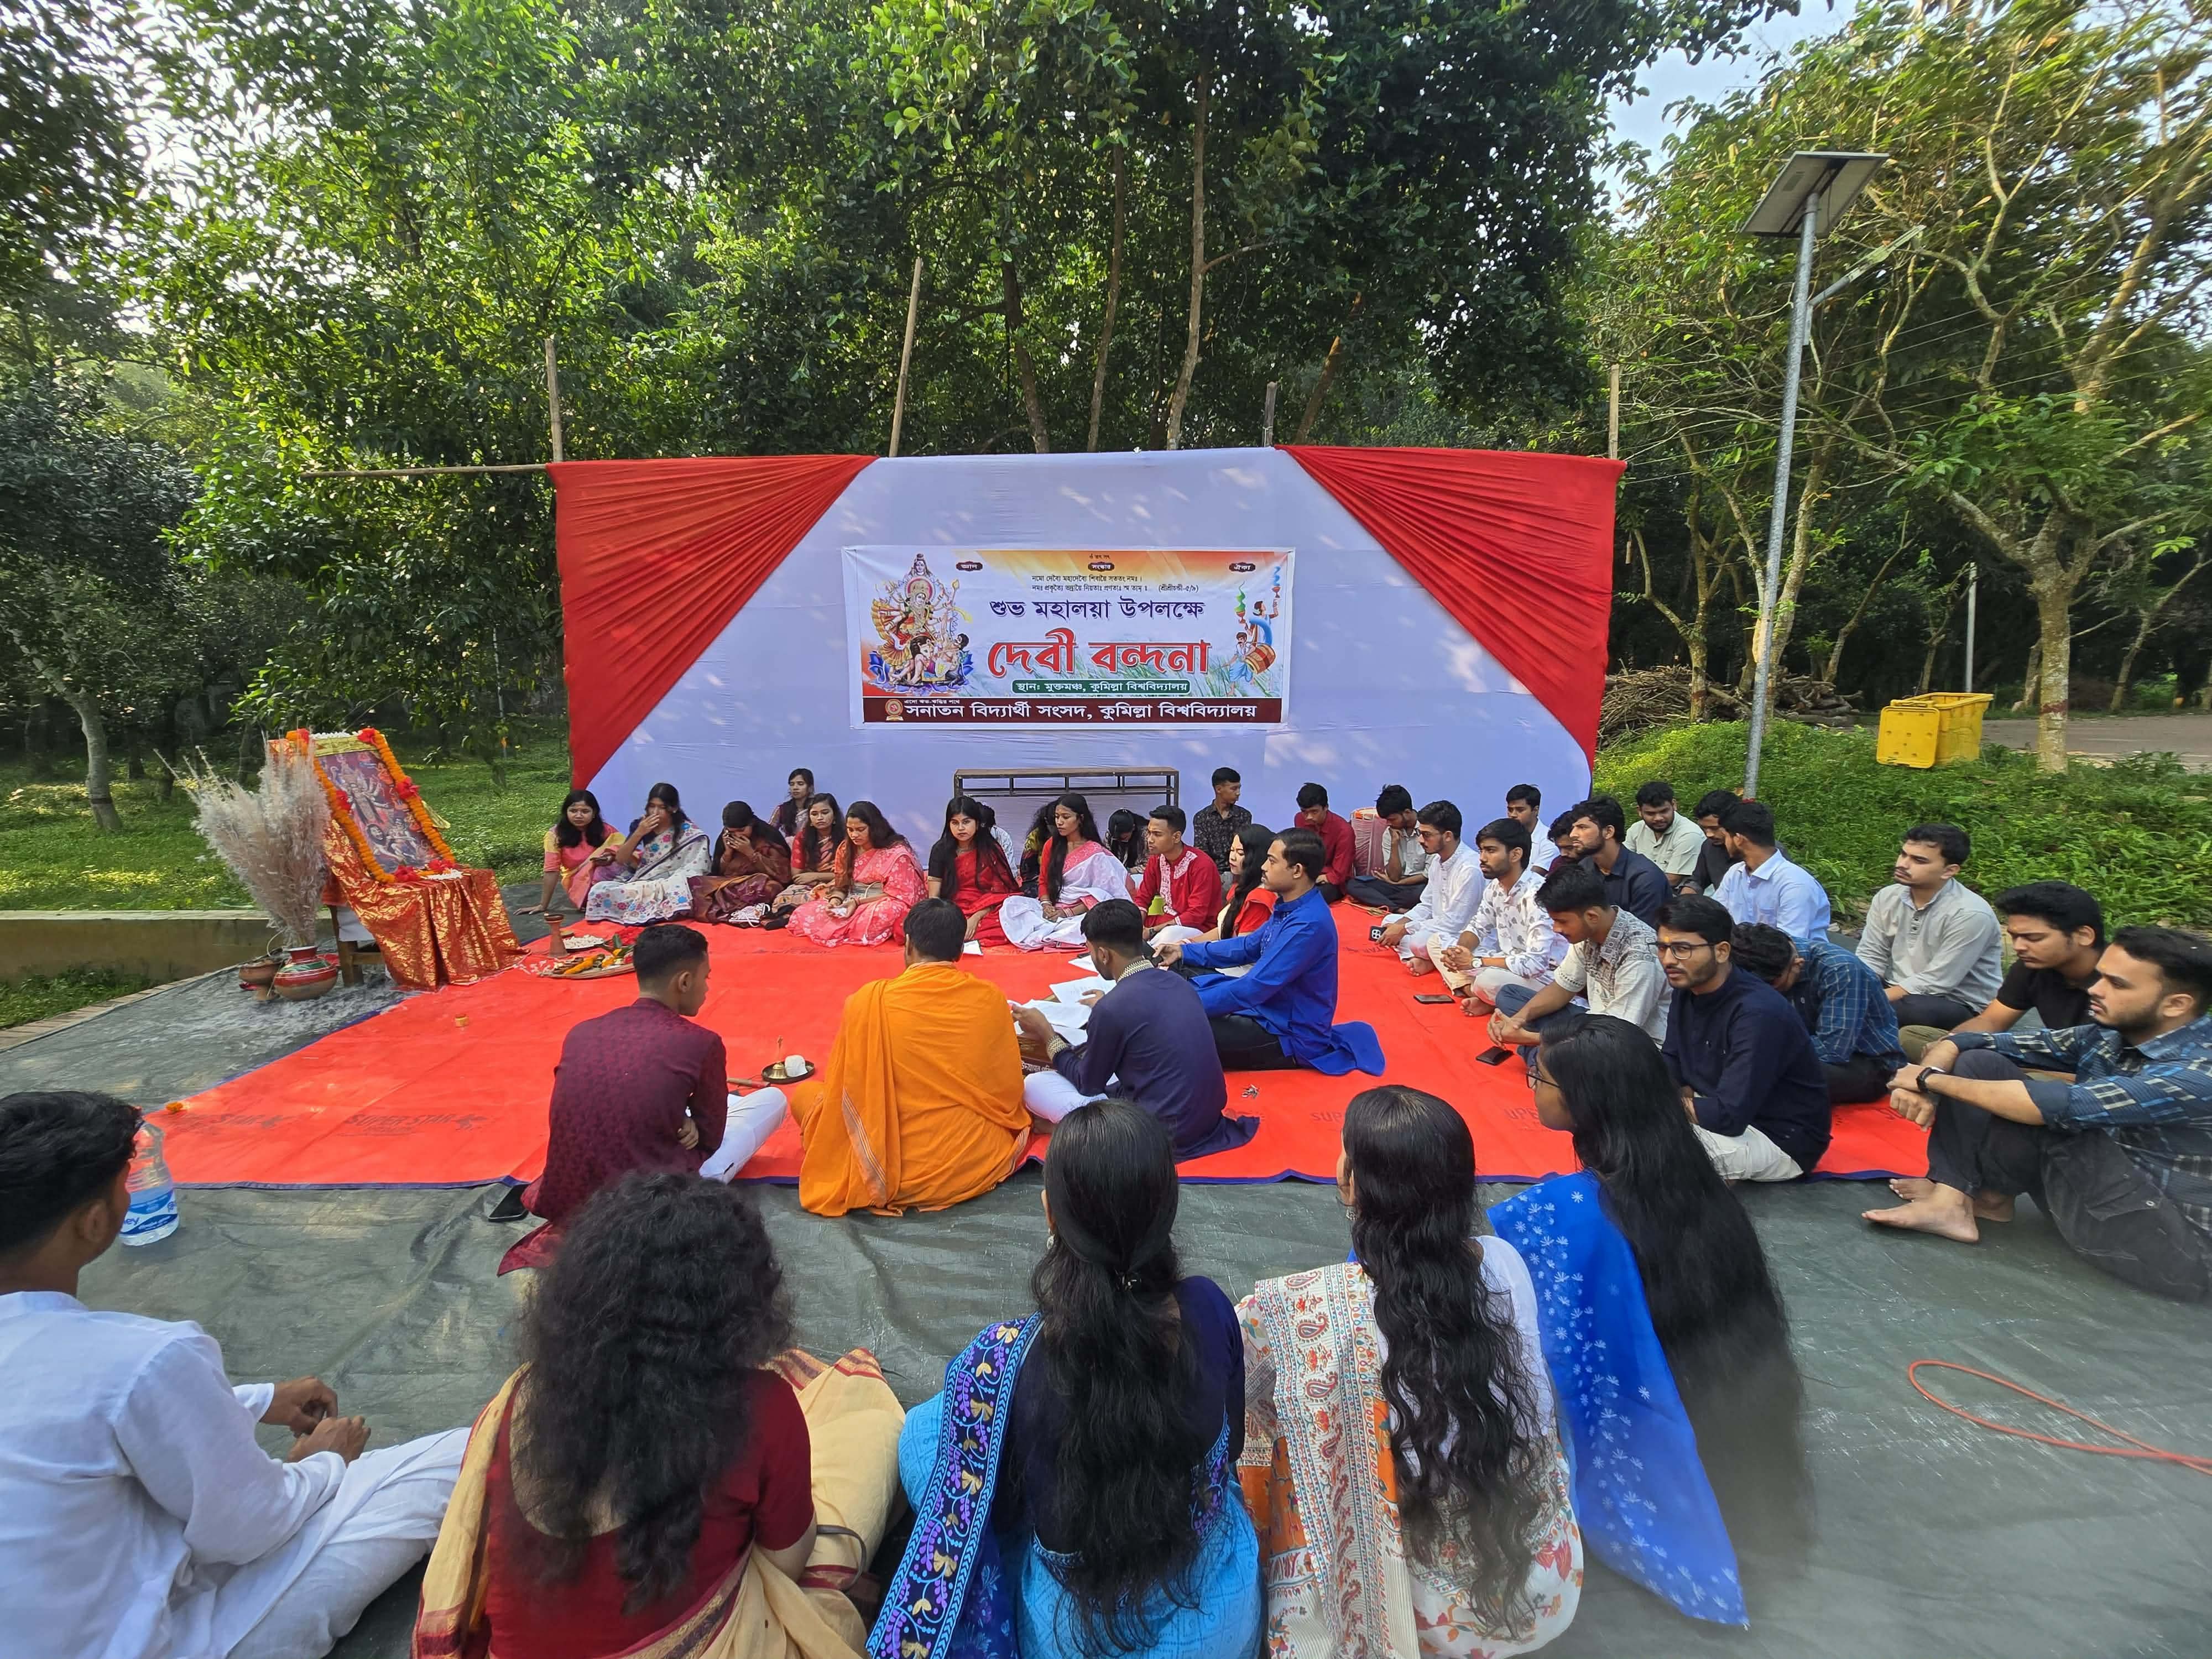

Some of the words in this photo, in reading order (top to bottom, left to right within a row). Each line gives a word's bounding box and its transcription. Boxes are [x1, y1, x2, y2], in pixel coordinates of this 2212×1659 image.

[989, 600, 1027, 617] শুভ
[1032, 599, 1111, 620] মহালয়া
[1118, 596, 1206, 619] উপলক্ষে
[988, 627, 1078, 678] দেবী
[1088, 639, 1213, 674] বন্দনা
[1089, 681, 1123, 692] কুমিল্লা
[1126, 681, 1188, 691] বিশ্ববিদ্যালয়
[904, 704, 964, 718] সনাতন
[969, 701, 1032, 718] বিদ্যার্থী
[1036, 705, 1093, 720] সংসদ,
[1098, 702, 1153, 721] কুমিল্লা
[1157, 702, 1258, 718] বিশ্ববিদ্যালয়
